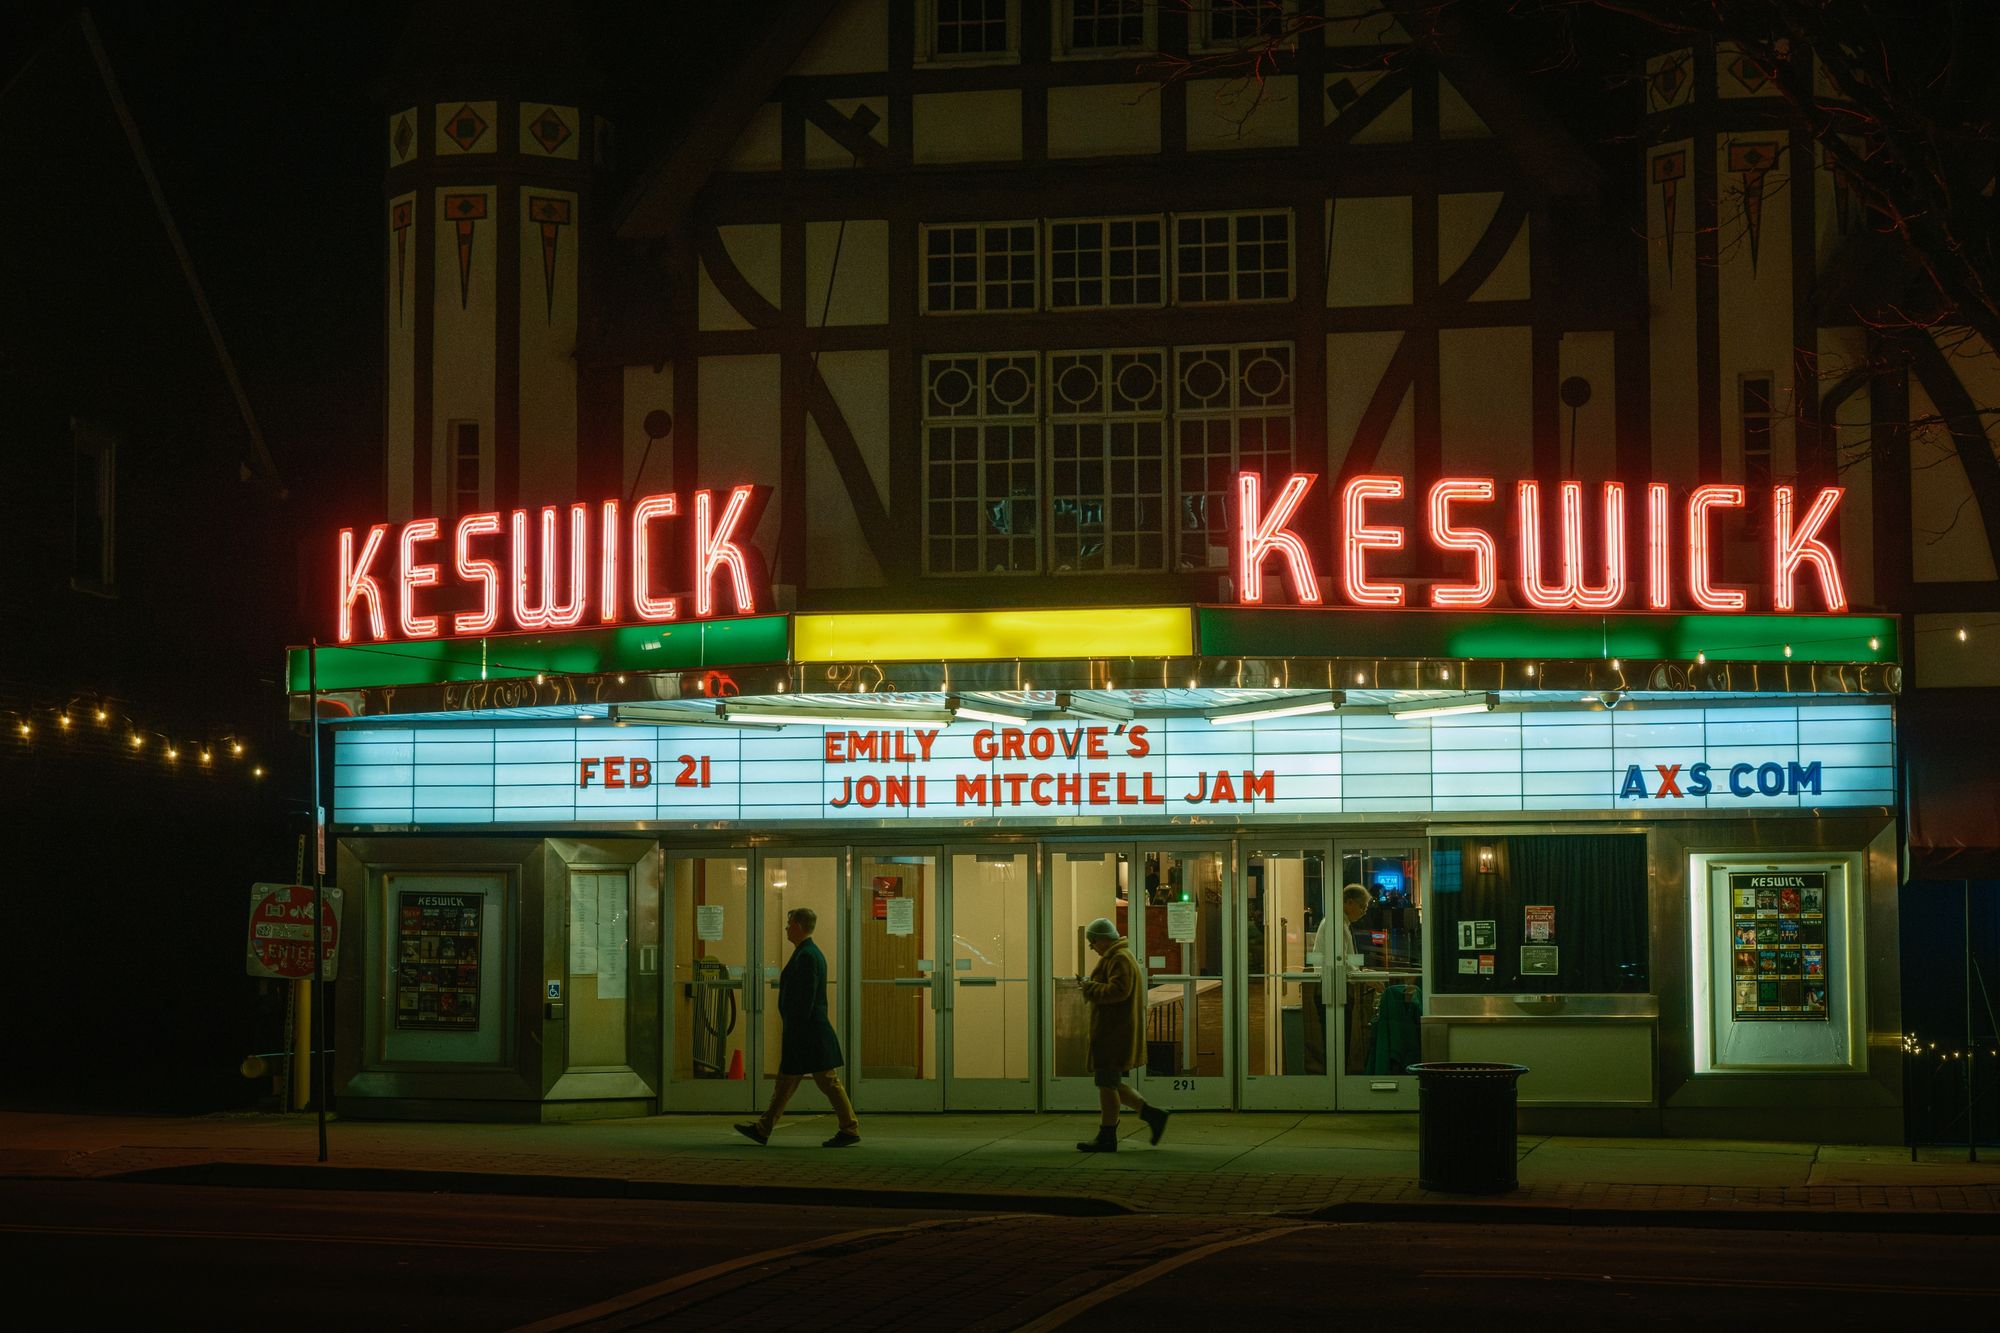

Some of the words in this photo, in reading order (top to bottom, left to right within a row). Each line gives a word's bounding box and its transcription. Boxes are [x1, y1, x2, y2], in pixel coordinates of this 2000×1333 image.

[1238, 471, 1848, 613] KESWICK
[339, 484, 755, 643] KESWICK
[825, 730, 940, 763] EMILY
[973, 724, 1150, 762] GROVE'S
[580, 756, 652, 789] FEB
[675, 754, 711, 788] 21
[830, 775, 926, 808] JONI
[956, 772, 1165, 807] MITCHELL
[1184, 770, 1275, 804] JAM
[1751, 877, 1806, 887] KESWICK
[417, 896, 465, 906] KESWICK
[1174, 1080, 1195, 1090] 291
